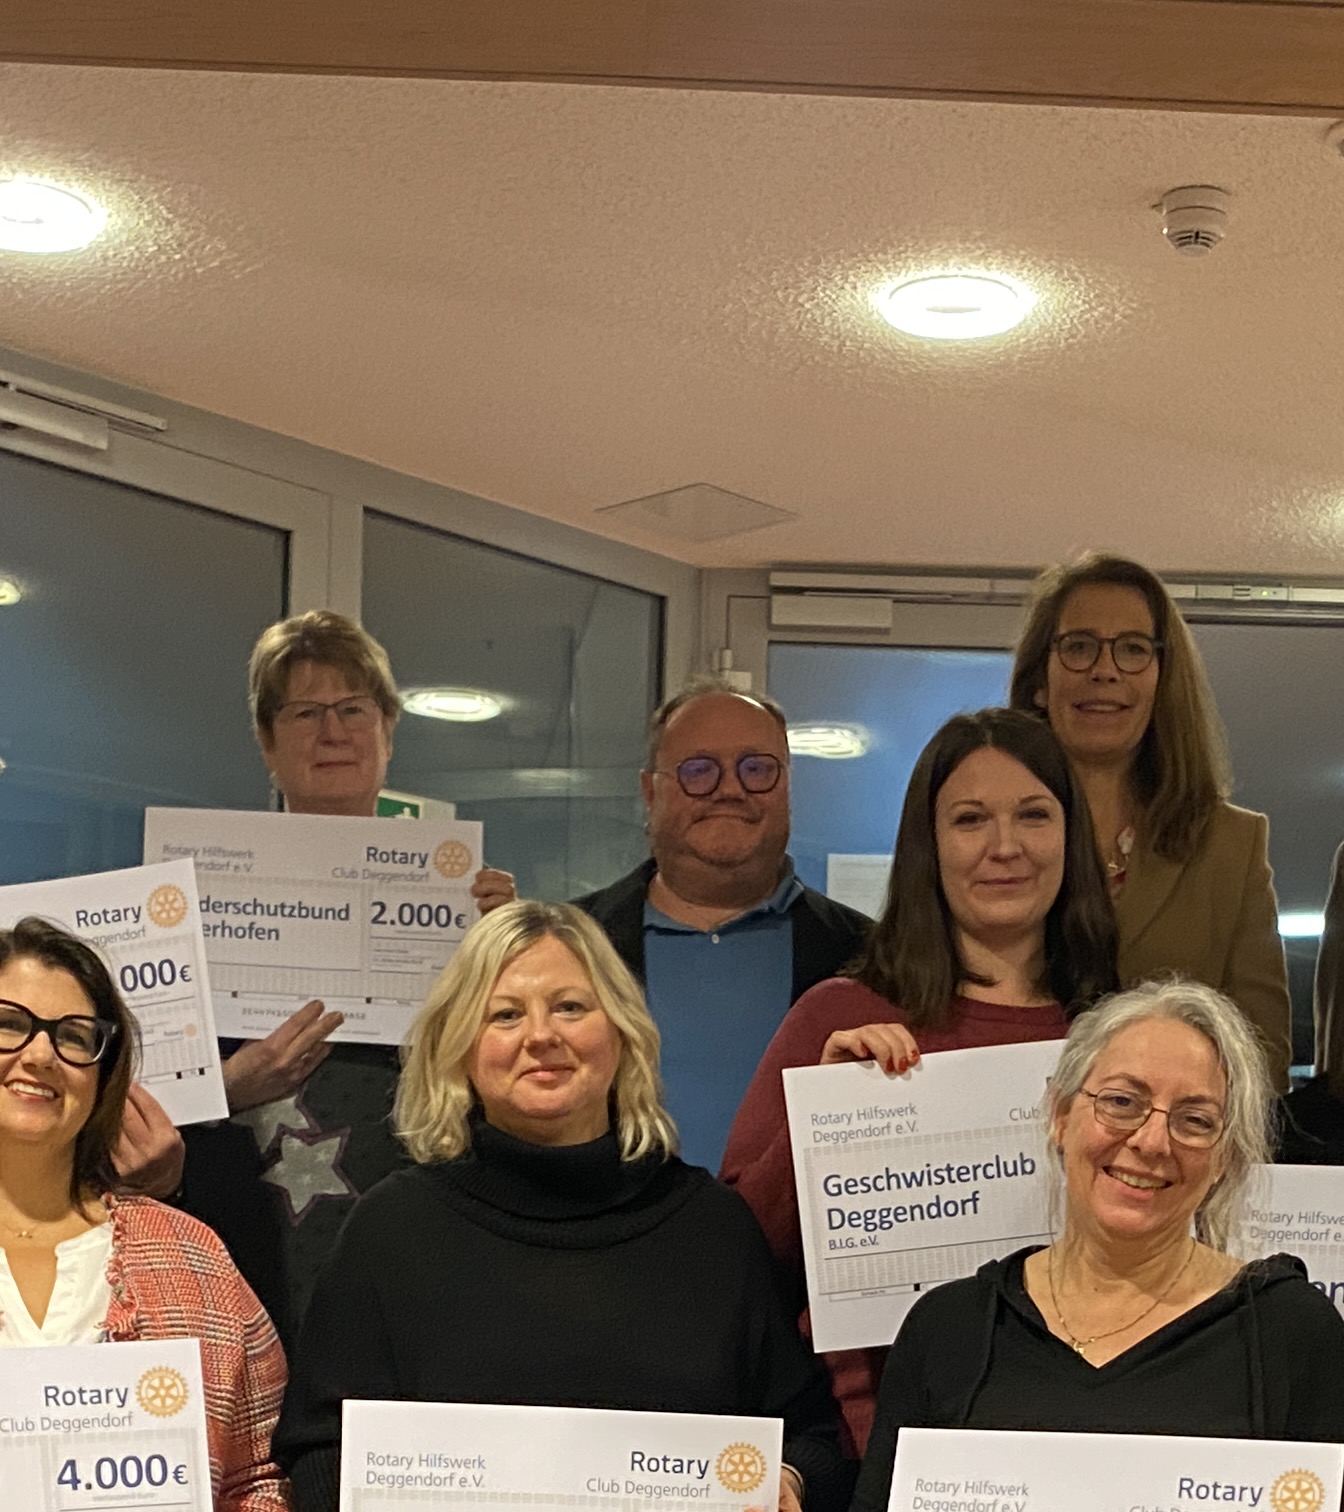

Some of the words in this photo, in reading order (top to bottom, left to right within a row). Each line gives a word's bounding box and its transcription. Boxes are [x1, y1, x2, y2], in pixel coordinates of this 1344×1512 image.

[365, 845, 429, 868] Rotary
[331, 867, 359, 880] Club
[362, 867, 430, 883] Deggendorf
[76, 905, 142, 928] Rotary
[199, 895, 350, 921] derschutzbund
[202, 920, 280, 941] erhofen
[119, 958, 193, 992] 000€
[810, 1111, 853, 1126] Rotary
[856, 1102, 918, 1121] Hilfswerk
[812, 1122, 892, 1145] Deggendorf
[895, 1120, 919, 1136] e.V.
[822, 1152, 1037, 1197] Geschwisterclub
[826, 1190, 981, 1233] Deggendorf
[859, 1234, 880, 1248] e.V.
[44, 1384, 129, 1408] Rotary
[40, 1411, 134, 1433] Deggendorf
[366, 1451, 413, 1469] Rotary
[418, 1452, 486, 1471] Hilfswerk
[630, 1450, 710, 1480] Rotary
[366, 1470, 455, 1489] Deggendorf
[458, 1473, 486, 1489] e.V.
[586, 1477, 620, 1494] Club
[624, 1480, 711, 1499] Deggendorf
[914, 1477, 960, 1496] Rotary
[963, 1480, 1030, 1497] Hilfswerk
[1178, 1476, 1264, 1507] Rotary
